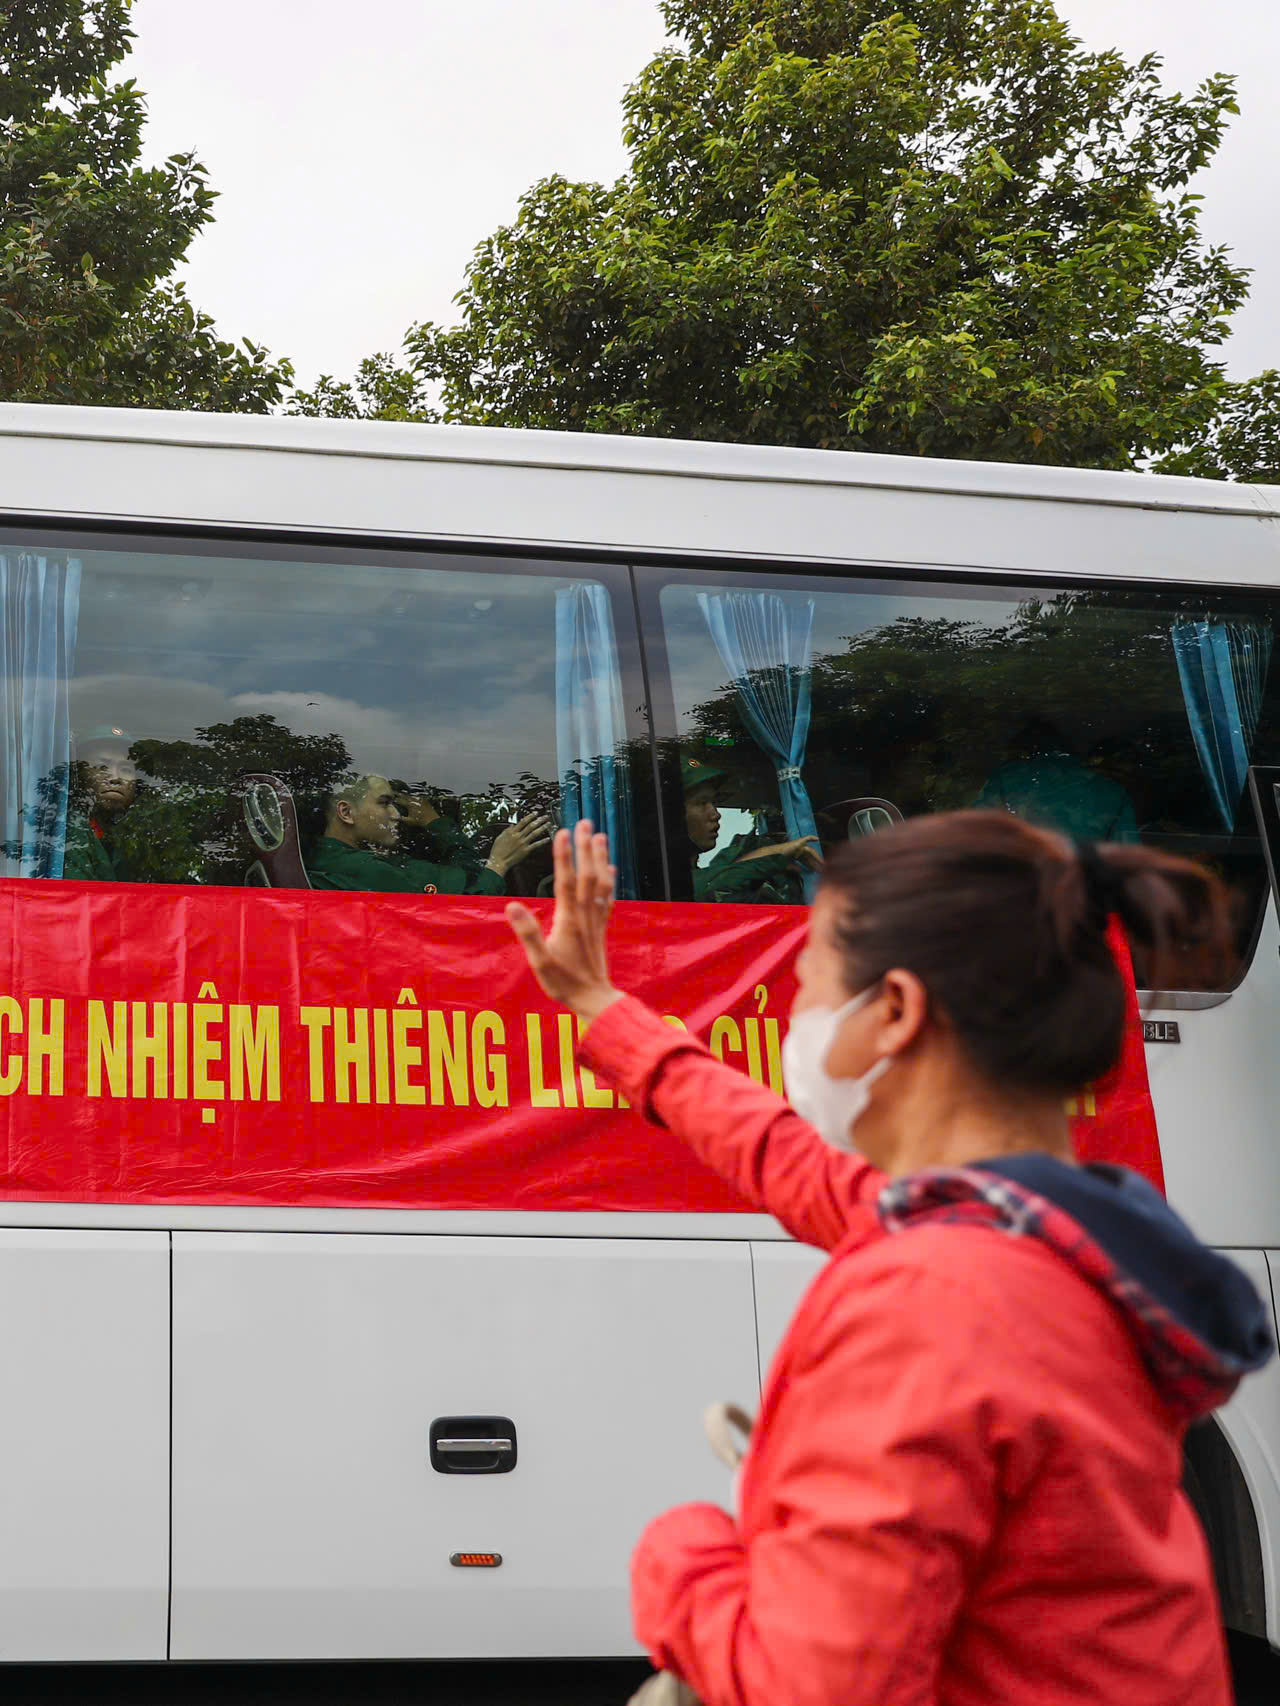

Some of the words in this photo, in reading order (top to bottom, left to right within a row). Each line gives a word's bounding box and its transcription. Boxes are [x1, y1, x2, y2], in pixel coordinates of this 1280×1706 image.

[87, 981, 280, 1123] NHIỆM
[300, 987, 508, 1108] THIÊNG
[1143, 1022, 1176, 1040] BLE
